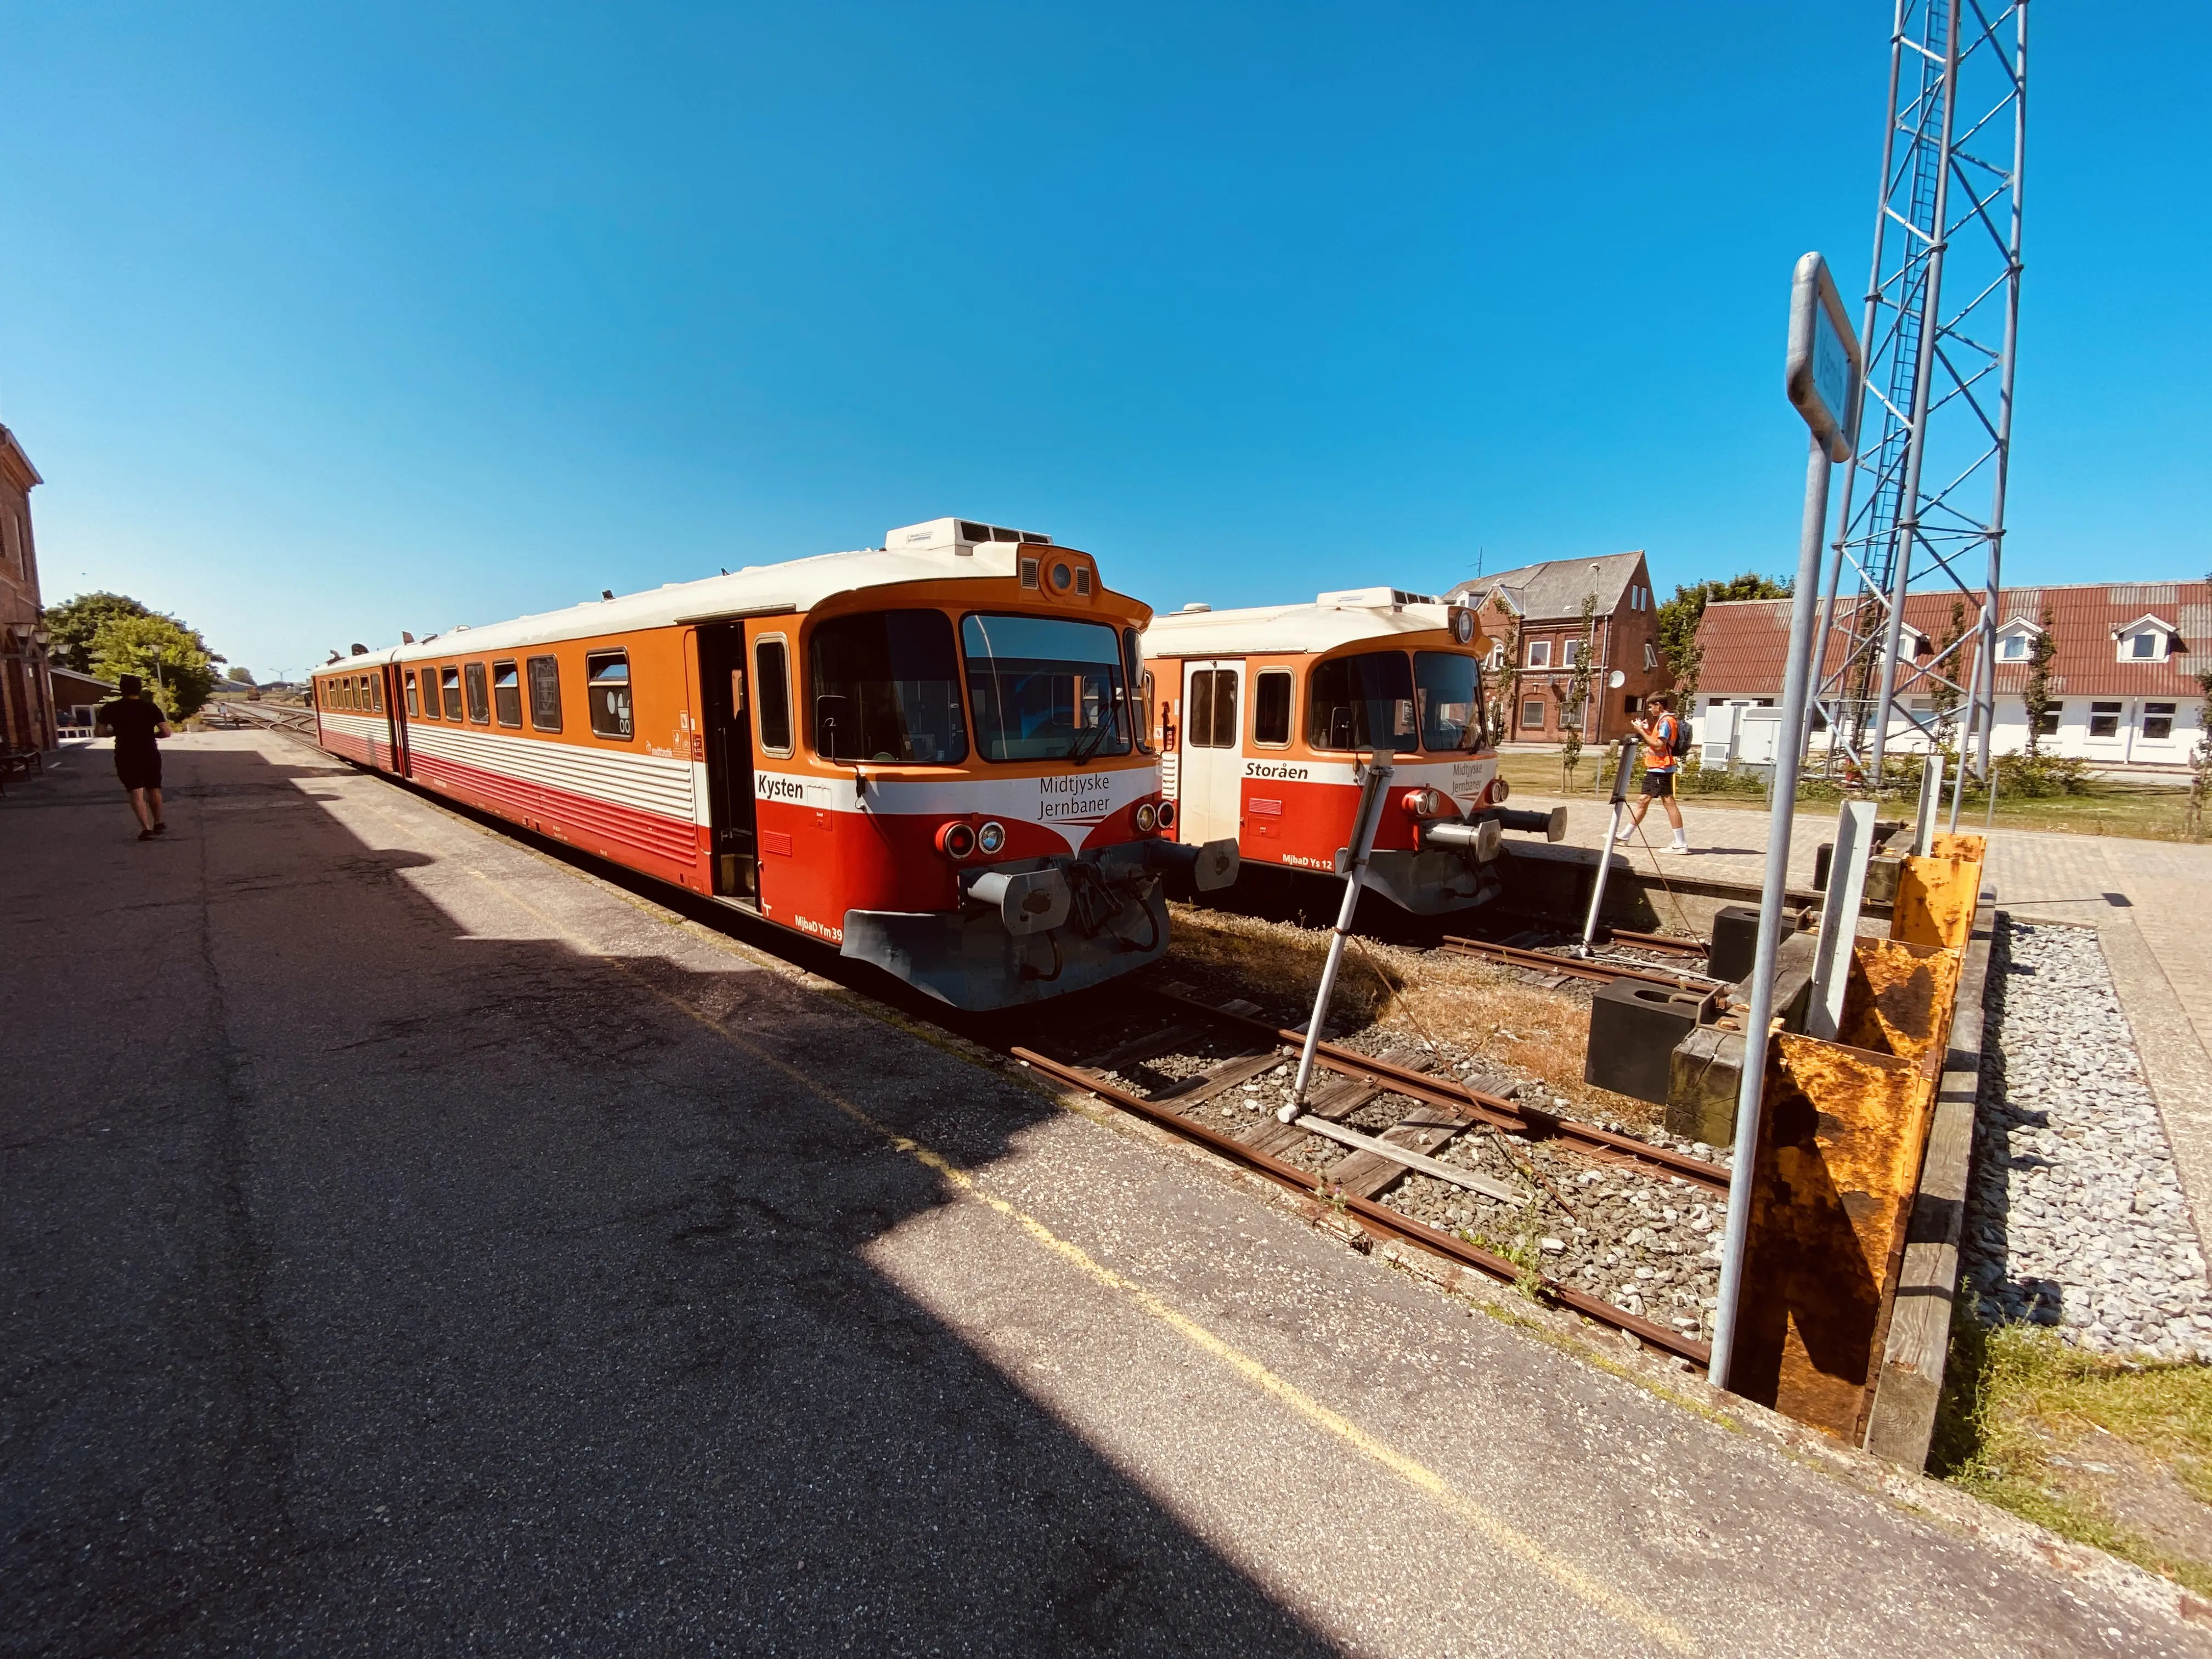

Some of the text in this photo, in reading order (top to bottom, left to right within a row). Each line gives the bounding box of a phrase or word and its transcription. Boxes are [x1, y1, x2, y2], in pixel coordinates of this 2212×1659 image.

[1245, 763, 1308, 779] Storåen
[1453, 762, 1482, 777] Midtjyske
[759, 775, 803, 799] Kysten
[1040, 773, 1109, 795] Midtjyske
[1451, 780, 1482, 795] Jernbaner
[1037, 797, 1110, 820] Jernbaner
[1283, 854, 1333, 870] MjbaD Ys 12
[794, 914, 843, 941] MjbaD Ym 39
